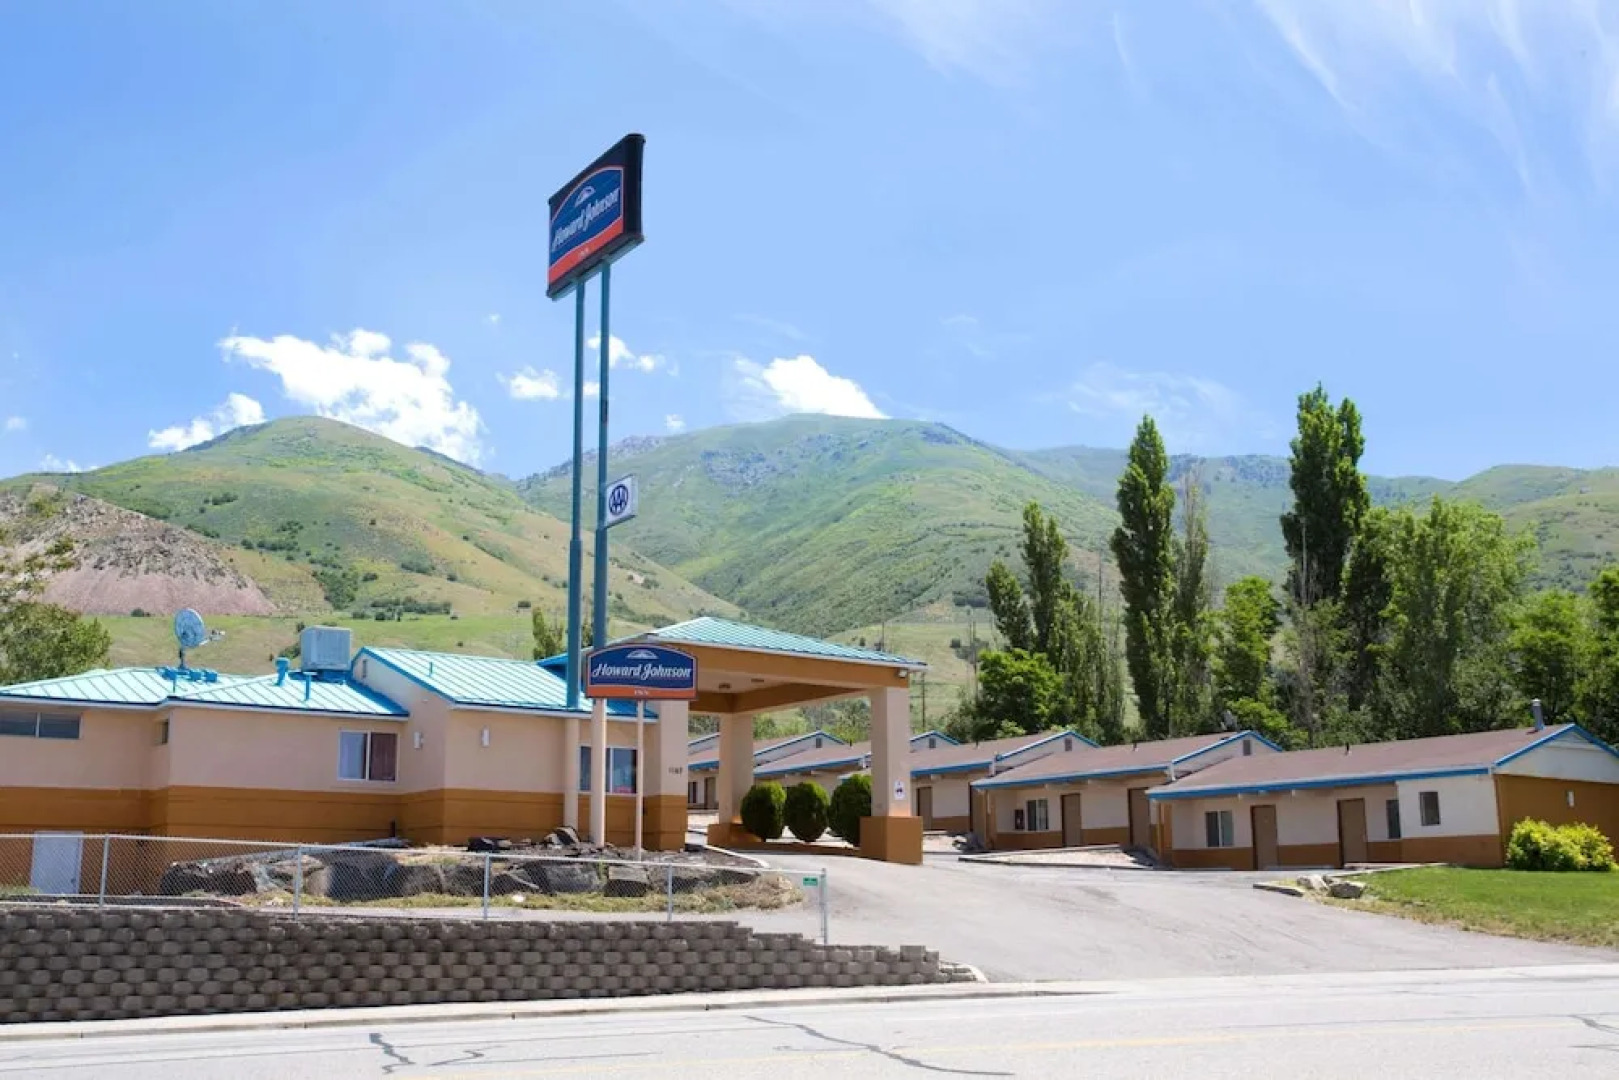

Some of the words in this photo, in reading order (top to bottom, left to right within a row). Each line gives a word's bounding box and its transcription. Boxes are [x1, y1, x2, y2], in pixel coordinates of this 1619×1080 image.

[552, 209, 585, 251] Howard
[583, 188, 620, 232] Johnson
[592, 663, 642, 677] Howard
[641, 663, 692, 680] Johnson
